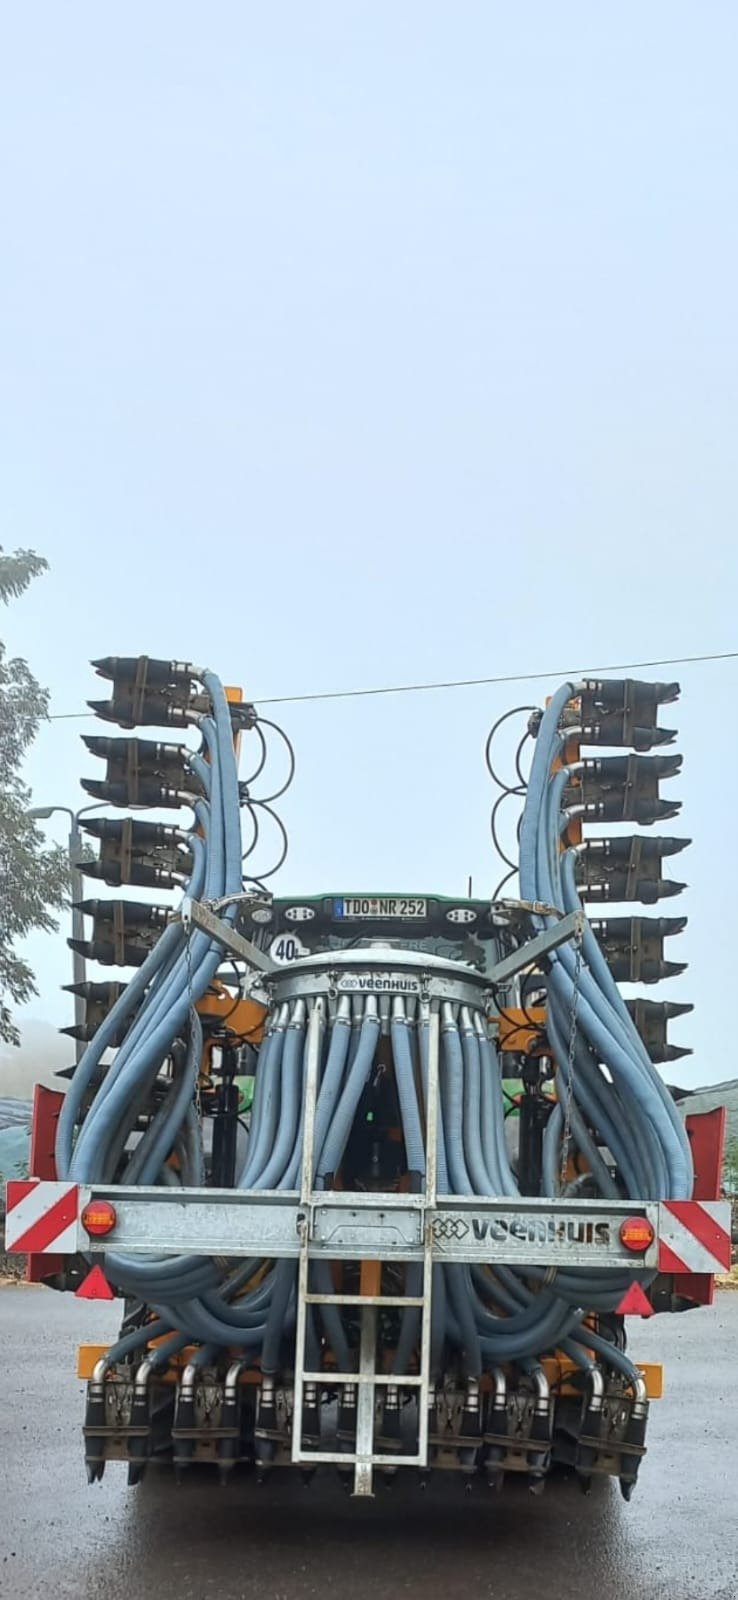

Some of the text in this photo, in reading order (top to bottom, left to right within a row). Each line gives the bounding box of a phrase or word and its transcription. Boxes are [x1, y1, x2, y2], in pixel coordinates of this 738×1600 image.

[345, 900, 424, 914] TDO NR 252
[275, 940, 295, 960] 40
